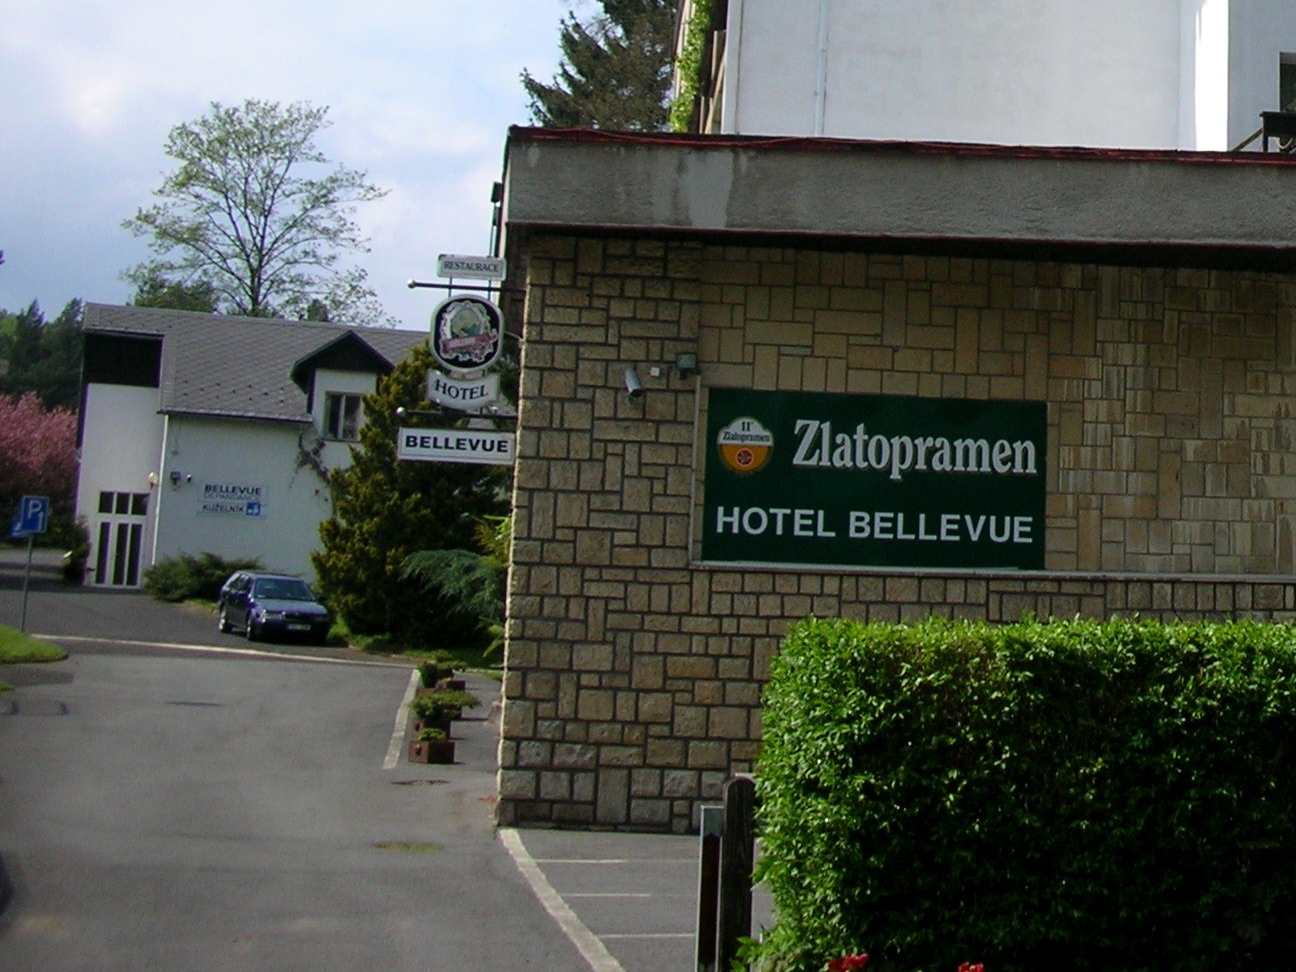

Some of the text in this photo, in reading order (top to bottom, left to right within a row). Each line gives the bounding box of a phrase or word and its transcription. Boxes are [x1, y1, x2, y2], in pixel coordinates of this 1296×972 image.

[443, 260, 499, 273] RESTAURACE
[434, 379, 489, 400] HOTEL
[405, 435, 509, 453] BELLEVUE
[792, 419, 1038, 480] Zlatopramen
[204, 483, 262, 496] BELLEVUE
[28, 499, 42, 520] P
[716, 506, 1034, 544] HOTEL BELLEVUE
